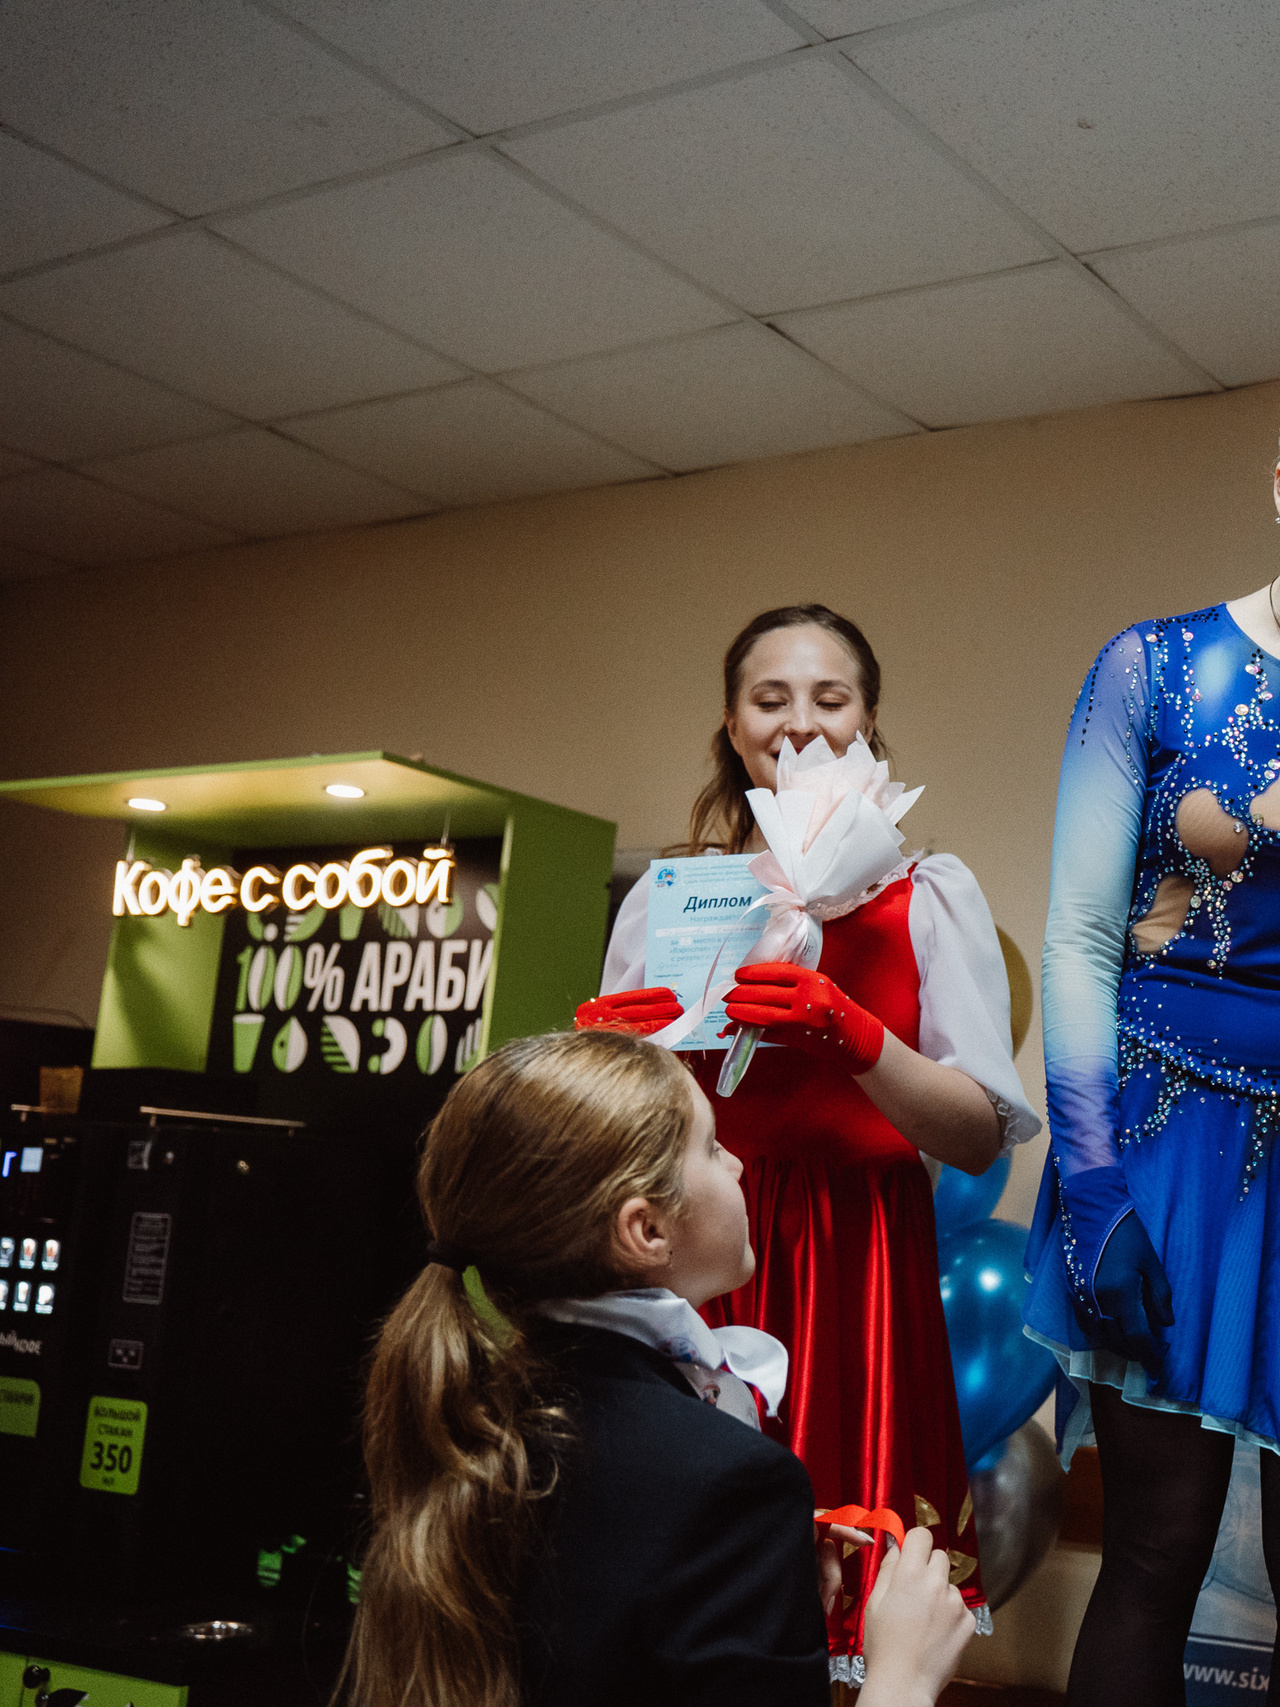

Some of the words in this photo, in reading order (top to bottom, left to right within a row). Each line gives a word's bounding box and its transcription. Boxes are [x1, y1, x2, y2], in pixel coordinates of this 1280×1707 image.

[112, 858, 239, 927] Кофе
[240, 866, 280, 912] с
[282, 847, 455, 912] собой
[683, 896, 752, 913] Диплом
[235, 942, 345, 1012] 100%
[350, 939, 495, 1012] АРАБИ
[94, 1406, 140, 1421] БОЛЬШОЙ
[98, 1424, 133, 1438] СТАКАН
[90, 1441, 131, 1473] 350
